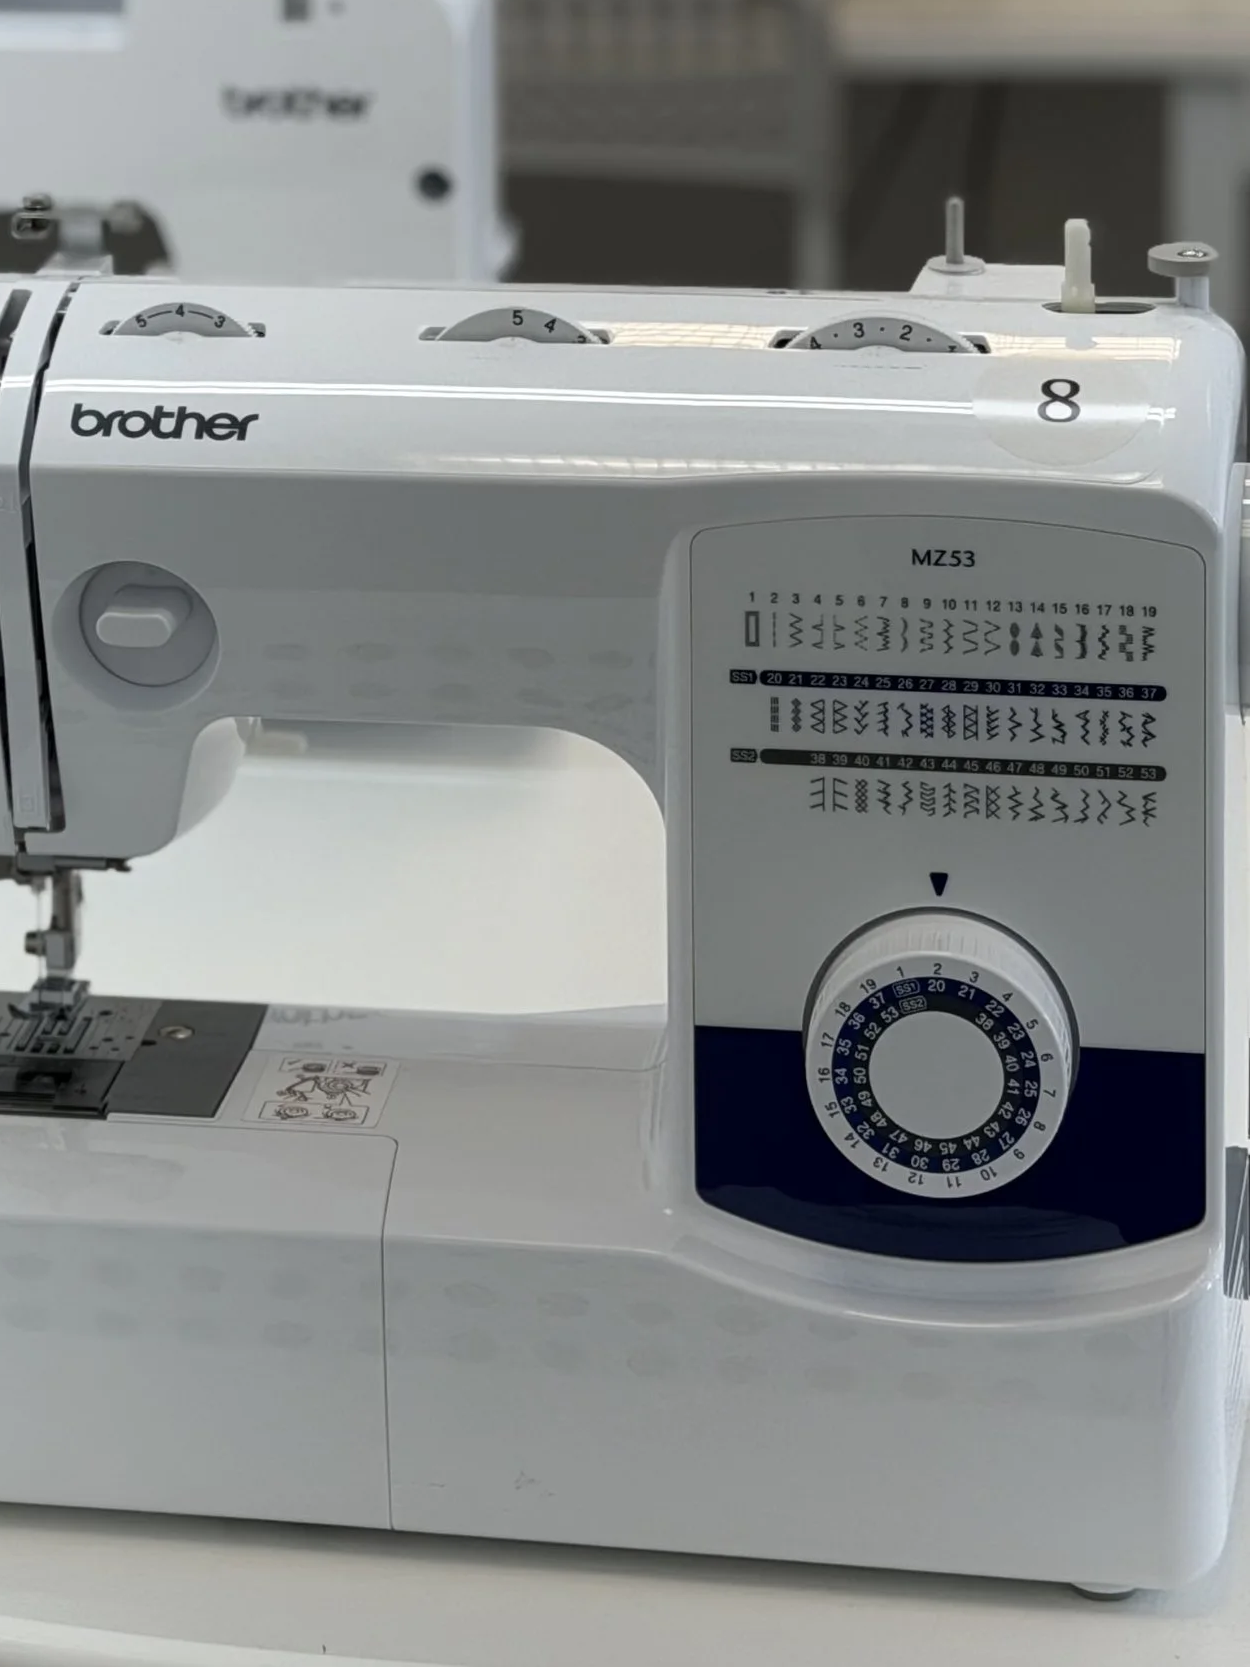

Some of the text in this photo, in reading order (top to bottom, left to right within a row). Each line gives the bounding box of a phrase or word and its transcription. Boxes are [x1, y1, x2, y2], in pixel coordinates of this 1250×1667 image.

[135, 304, 226, 329] 5 4 3
[512, 310, 557, 334] 5 4
[853, 322, 865, 339] 3
[899, 324, 913, 341] 2
[1037, 378, 1081, 423] 8
[70, 402, 260, 442] brother
[911, 548, 976, 567] MZ53
[770, 591, 778, 604] 2
[791, 593, 800, 604] 3
[813, 593, 821, 605] 4
[835, 594, 844, 606] 5
[857, 595, 865, 607] 6
[879, 595, 888, 607] 7
[900, 596, 909, 609] 8
[923, 597, 931, 609] 9
[942, 598, 957, 610] 10
[963, 599, 977, 611] 11
[986, 599, 1001, 612] 12
[1008, 601, 1023, 613] 13
[1030, 601, 1045, 613] 14
[1052, 602, 1067, 614] 15
[1075, 603, 1090, 615] 16
[1097, 604, 1112, 616] 17
[1119, 604, 1134, 617] 18
[1141, 605, 1157, 617] 19
[732, 671, 1157, 699] SS1 20 21 22 23 24 25 26 27 28 29 30 31 32 33 34 35 36 37
[732, 749, 1156, 779] SS2 38 39 40 41 42 43 44 45 46 47 48 49 50 51 52 53
[818, 963, 1056, 1188] 1 2 3 4 5 6 7 8 9 10 11 12 13 14 15 16 17 18 19
[836, 980, 1037, 1170] SS1 20 21 22 23 24 25 26 27 28 29 30 31 32 33 34 35 36 37
[854, 1000, 1020, 1154] SS2 38 39 40 41 42 43 44 45 46 47 48 49 50 51 52 53
